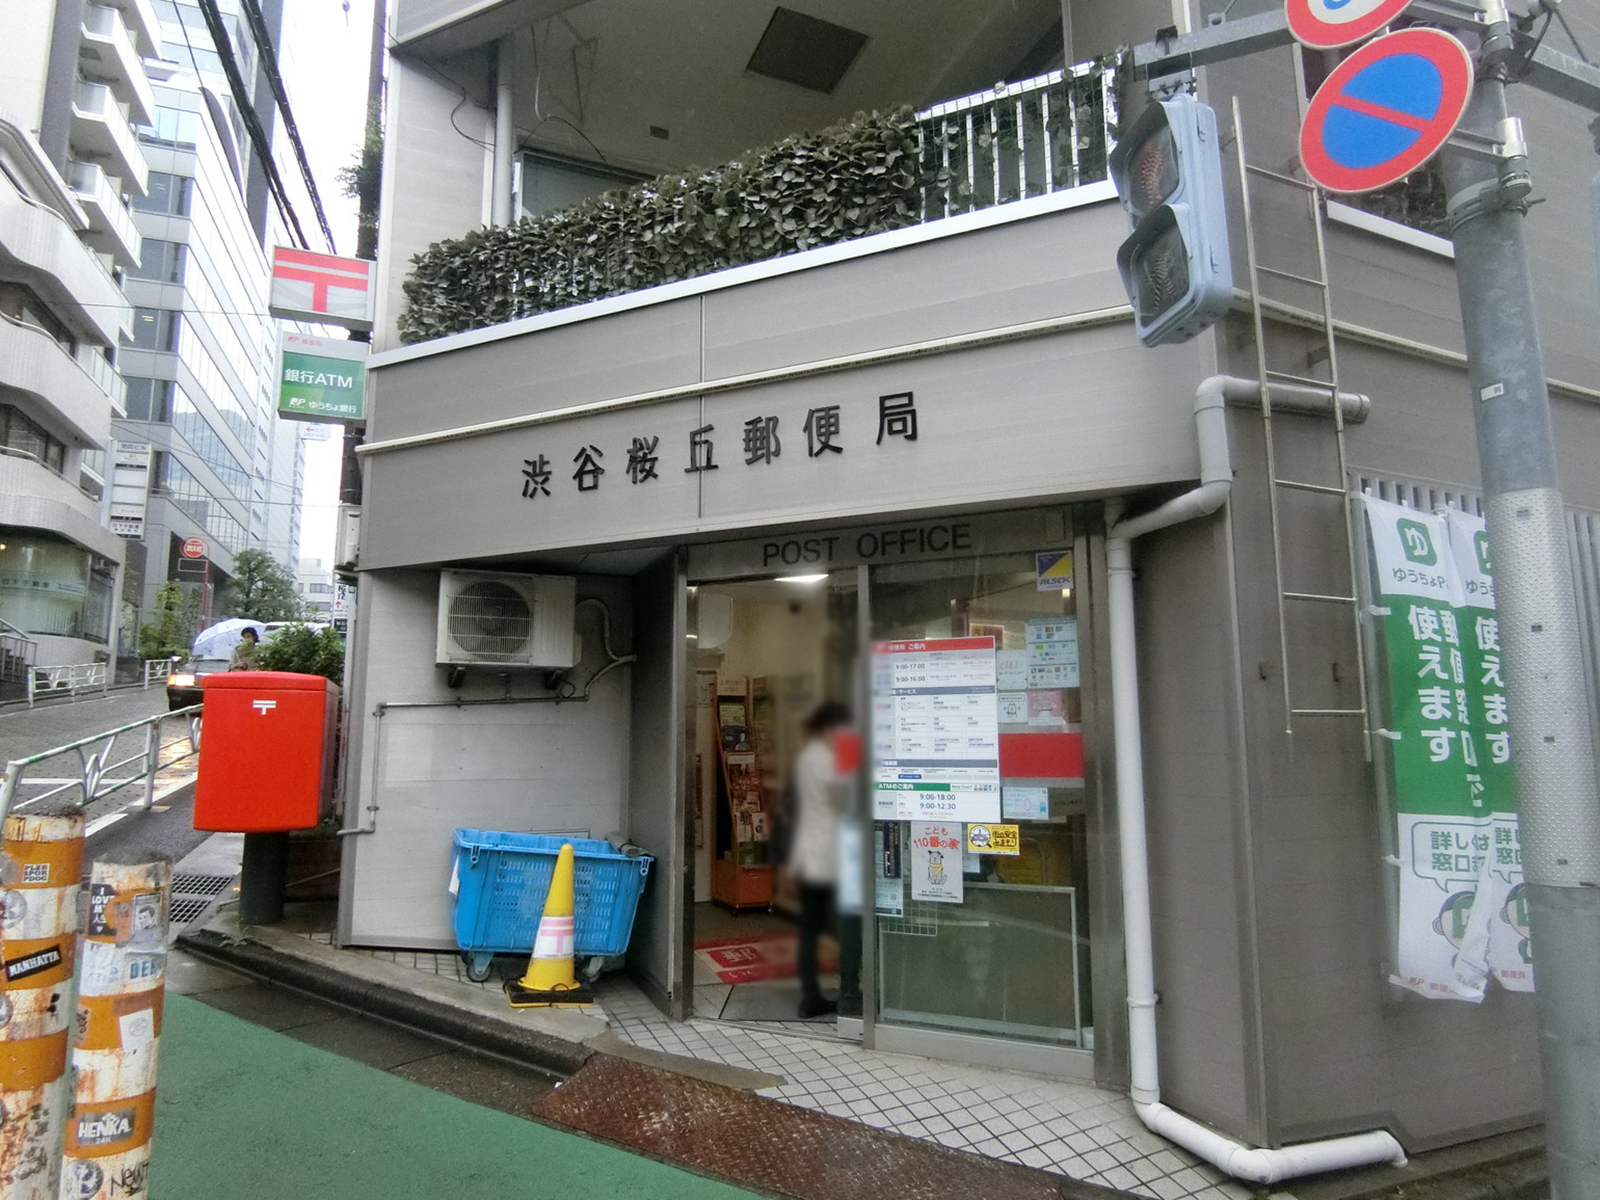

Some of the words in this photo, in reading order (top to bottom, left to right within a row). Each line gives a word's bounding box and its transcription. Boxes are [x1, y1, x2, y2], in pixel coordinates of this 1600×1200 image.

[284, 368, 353, 389] 銀行ATM
[308, 401, 357, 413] ゆうちょ銀行
[521, 391, 918, 499] 渋谷桜丘郵便局
[762, 536, 841, 567] POST
[856, 523, 973, 559] OFFICE
[1408, 604, 1456, 763] 使えます
[919, 793, 956, 801] 9:00-18:00
[924, 826, 948, 836] こども
[913, 836, 961, 850] 110番の家
[77, 1115, 132, 1139] HENKA
